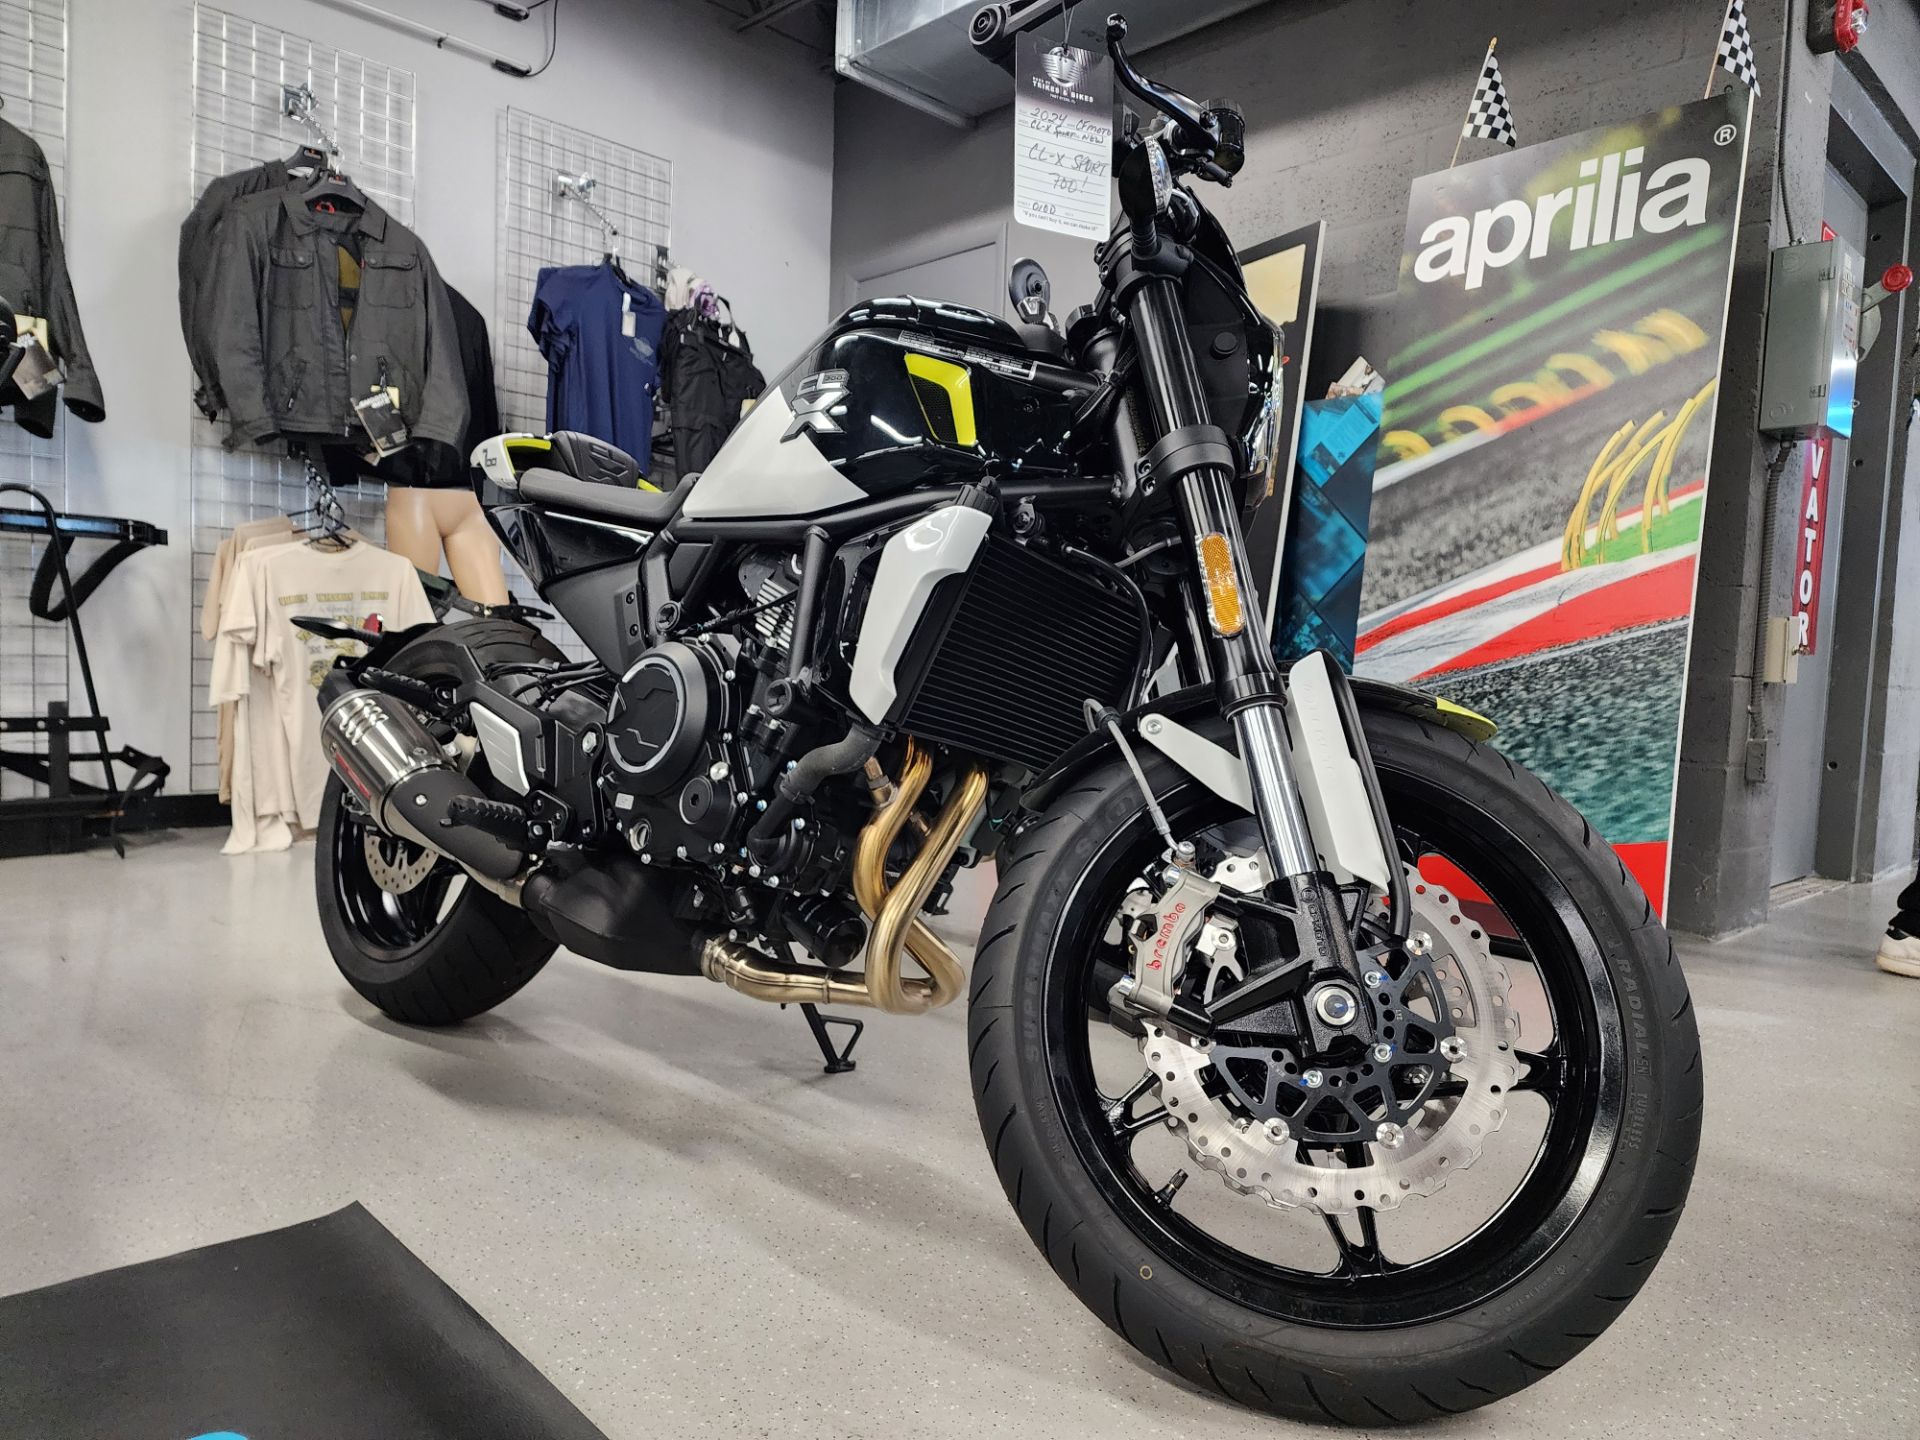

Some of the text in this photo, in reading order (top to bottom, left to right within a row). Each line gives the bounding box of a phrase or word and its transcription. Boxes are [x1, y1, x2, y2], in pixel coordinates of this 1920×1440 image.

[1030, 107, 1068, 127] 2024
[1070, 91, 1094, 103] BIKES
[1029, 143, 1065, 167] CL-X
[1413, 146, 1711, 290] aprilia
[1146, 902, 1186, 970] brembo
[1616, 959, 1649, 1054] RADIAL
